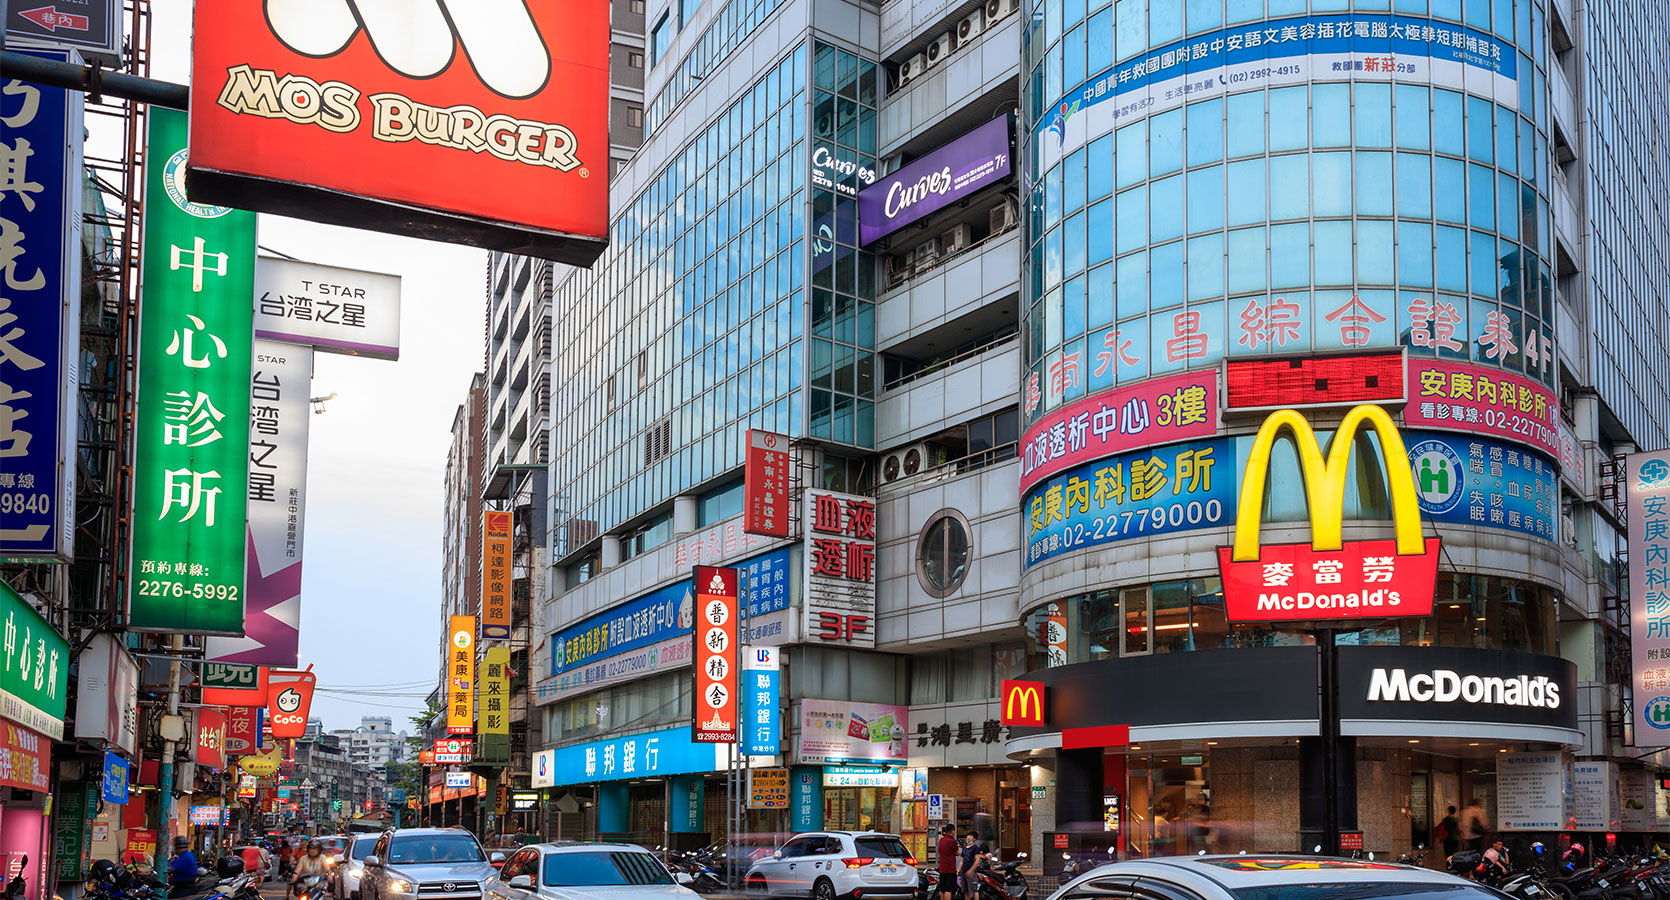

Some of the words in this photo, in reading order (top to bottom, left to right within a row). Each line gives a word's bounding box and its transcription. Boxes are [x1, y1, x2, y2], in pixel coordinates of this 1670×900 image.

[1229, 72, 1248, 84] (02)
[1250, 64, 1300, 80] 2992-4915
[1332, 56, 1416, 74] 救國團新莊分部
[216, 63, 361, 133] MOS
[368, 92, 582, 173] BURGER
[813, 147, 875, 184] Curves
[994, 154, 1007, 170] 7F
[884, 166, 951, 219] Curves
[301, 280, 313, 291] T
[319, 283, 366, 300] STAR
[257, 354, 287, 365] STAR
[1025, 293, 1518, 418] 華南永昌綜合證券
[1525, 328, 1552, 374] 4F
[158, 236, 229, 527] 中心診所
[1419, 368, 1547, 422] 安庚內科診所
[1156, 384, 1208, 427] 3樓
[1485, 409, 1560, 452] 02-2277900
[0, 493, 50, 515] 9840
[1030, 446, 1216, 537] 安庚內科診所
[1506, 449, 1522, 528] 高血壓
[813, 494, 875, 539] 血液
[1063, 499, 1223, 548] 02-22779000
[140, 560, 210, 578] 預約專線:
[812, 538, 875, 582] 透析
[1262, 556, 1395, 587] 麥當勞
[139, 579, 238, 602] 2276-5992
[774, 557, 785, 609] 一般內科
[1257, 589, 1401, 611] McDonald's
[741, 620, 783, 643] 有交通車服務
[819, 611, 869, 641] 3F
[4, 611, 59, 700] 中心診所
[708, 602, 726, 706] 普新精舍
[1366, 668, 1561, 709] McDonald's
[1642, 680, 1670, 691] 析中
[273, 714, 304, 725] CoCo
[757, 674, 771, 742] 聯邦銀行
[585, 737, 659, 777] 聯邦銀行
[704, 732, 735, 742] 2993-8284
[801, 785, 812, 825] 聯邦銀行
